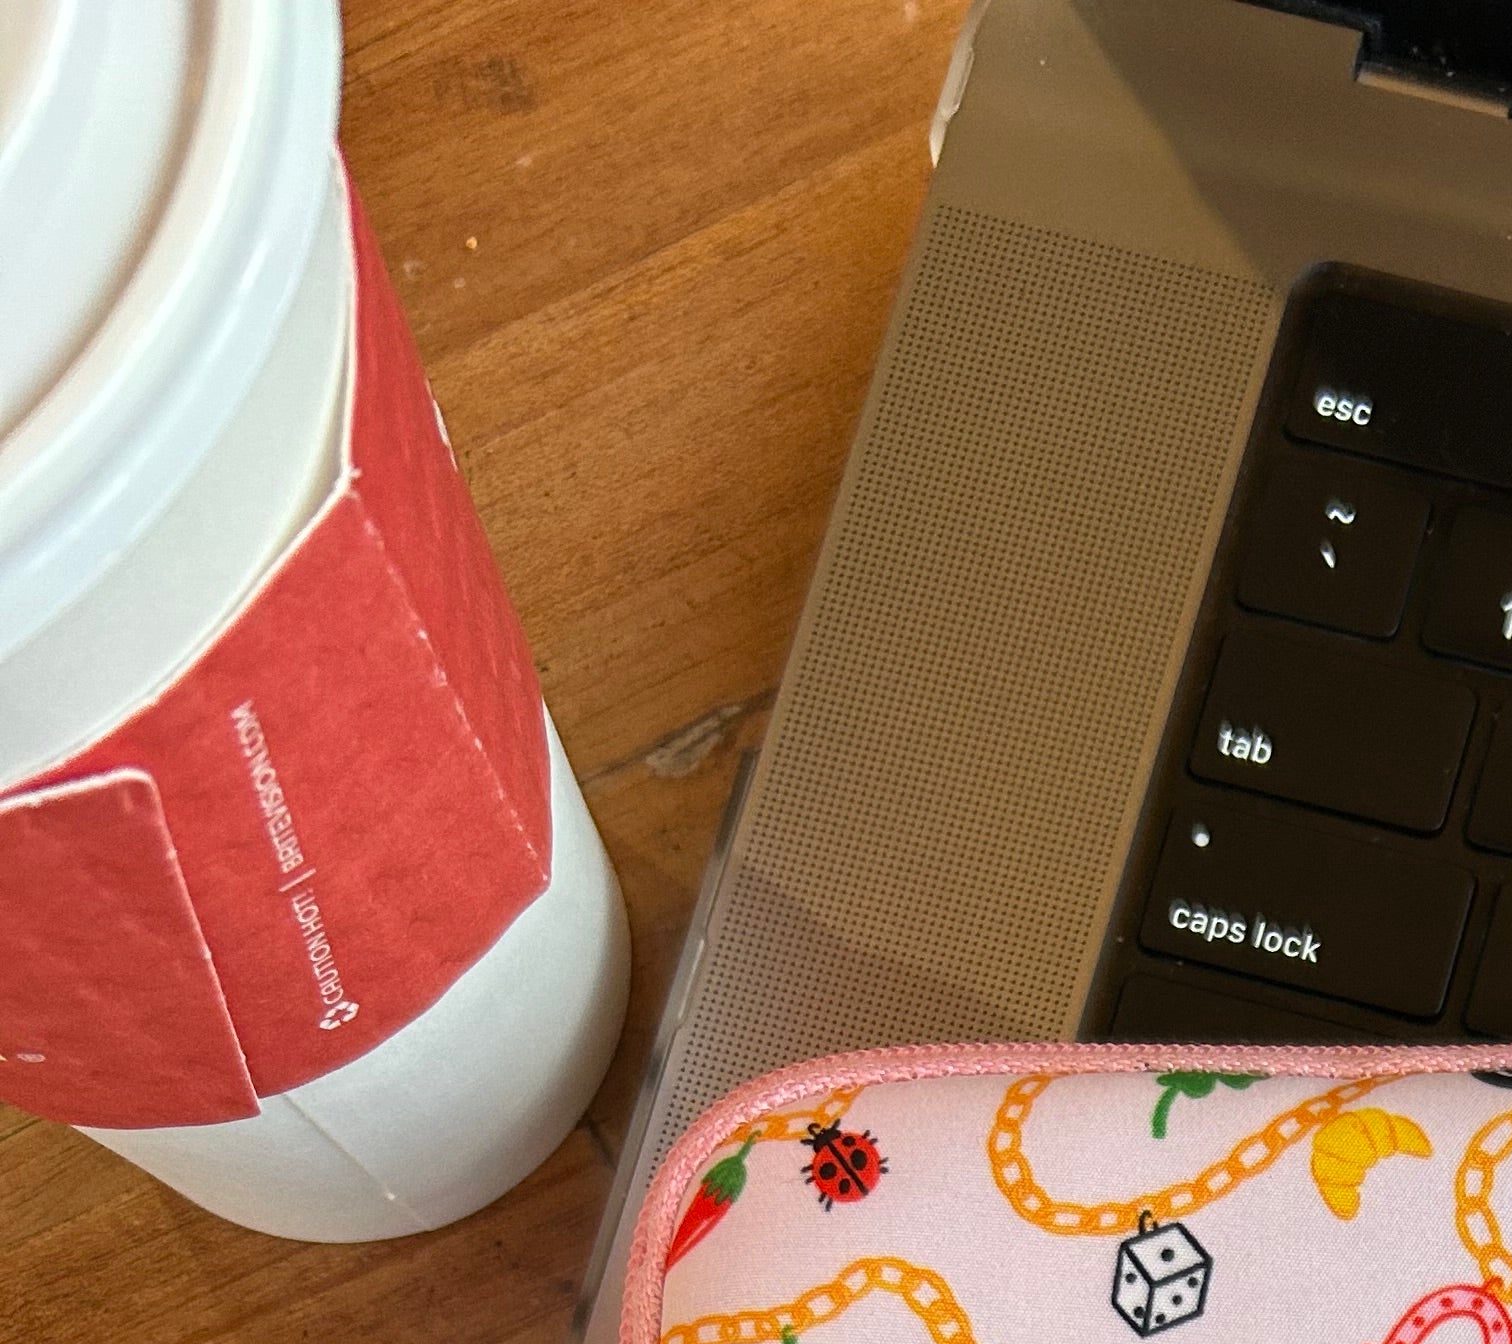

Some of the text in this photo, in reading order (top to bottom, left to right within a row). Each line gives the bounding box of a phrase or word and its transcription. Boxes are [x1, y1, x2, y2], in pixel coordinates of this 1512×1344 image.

[1316, 395, 1372, 426] esc
[1220, 730, 1272, 764] tab
[1170, 908, 1321, 963] caps lock
[305, 931, 345, 1006] CAUTION
